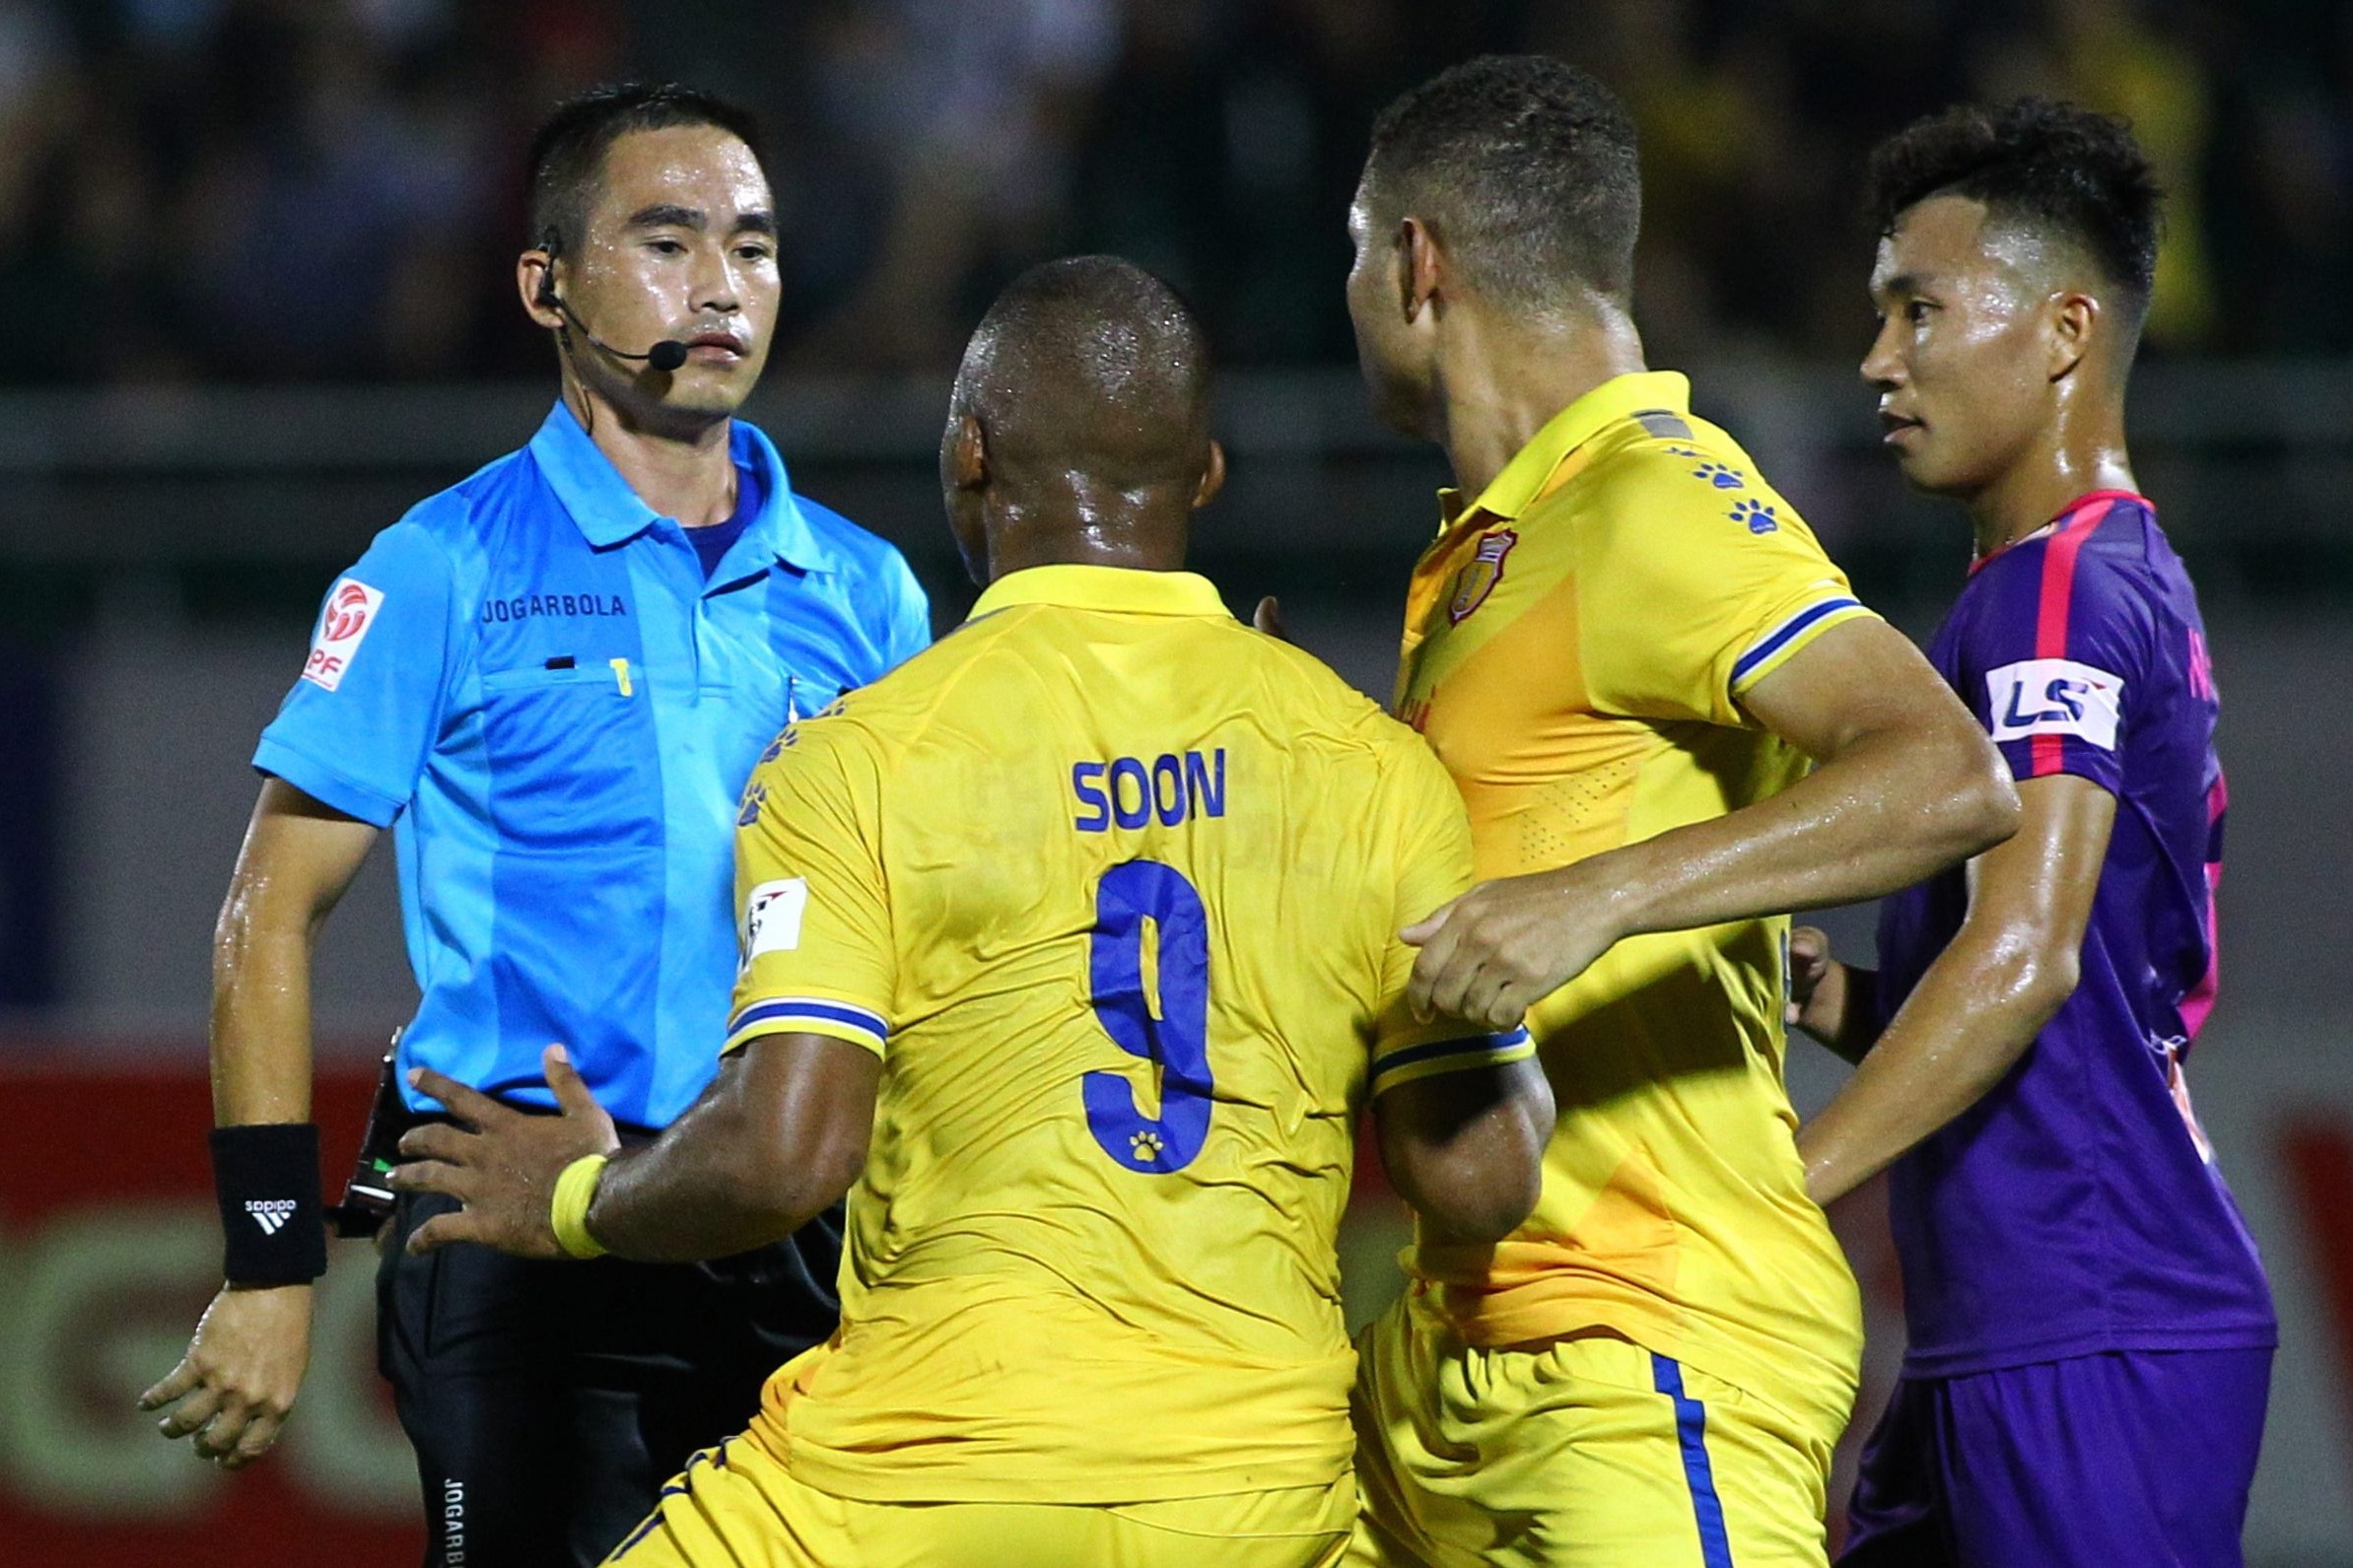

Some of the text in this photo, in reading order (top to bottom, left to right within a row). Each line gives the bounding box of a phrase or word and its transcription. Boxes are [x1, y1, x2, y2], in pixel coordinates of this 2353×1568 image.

[481, 593, 627, 624] JOGARBOLA
[307, 648, 343, 675] PF
[2003, 678, 2089, 728] LS
[1072, 748, 1225, 833] SOON
[1081, 858, 1213, 1175] 9
[244, 1199, 298, 1214] adidas
[444, 1477, 464, 1568] JOGARB
